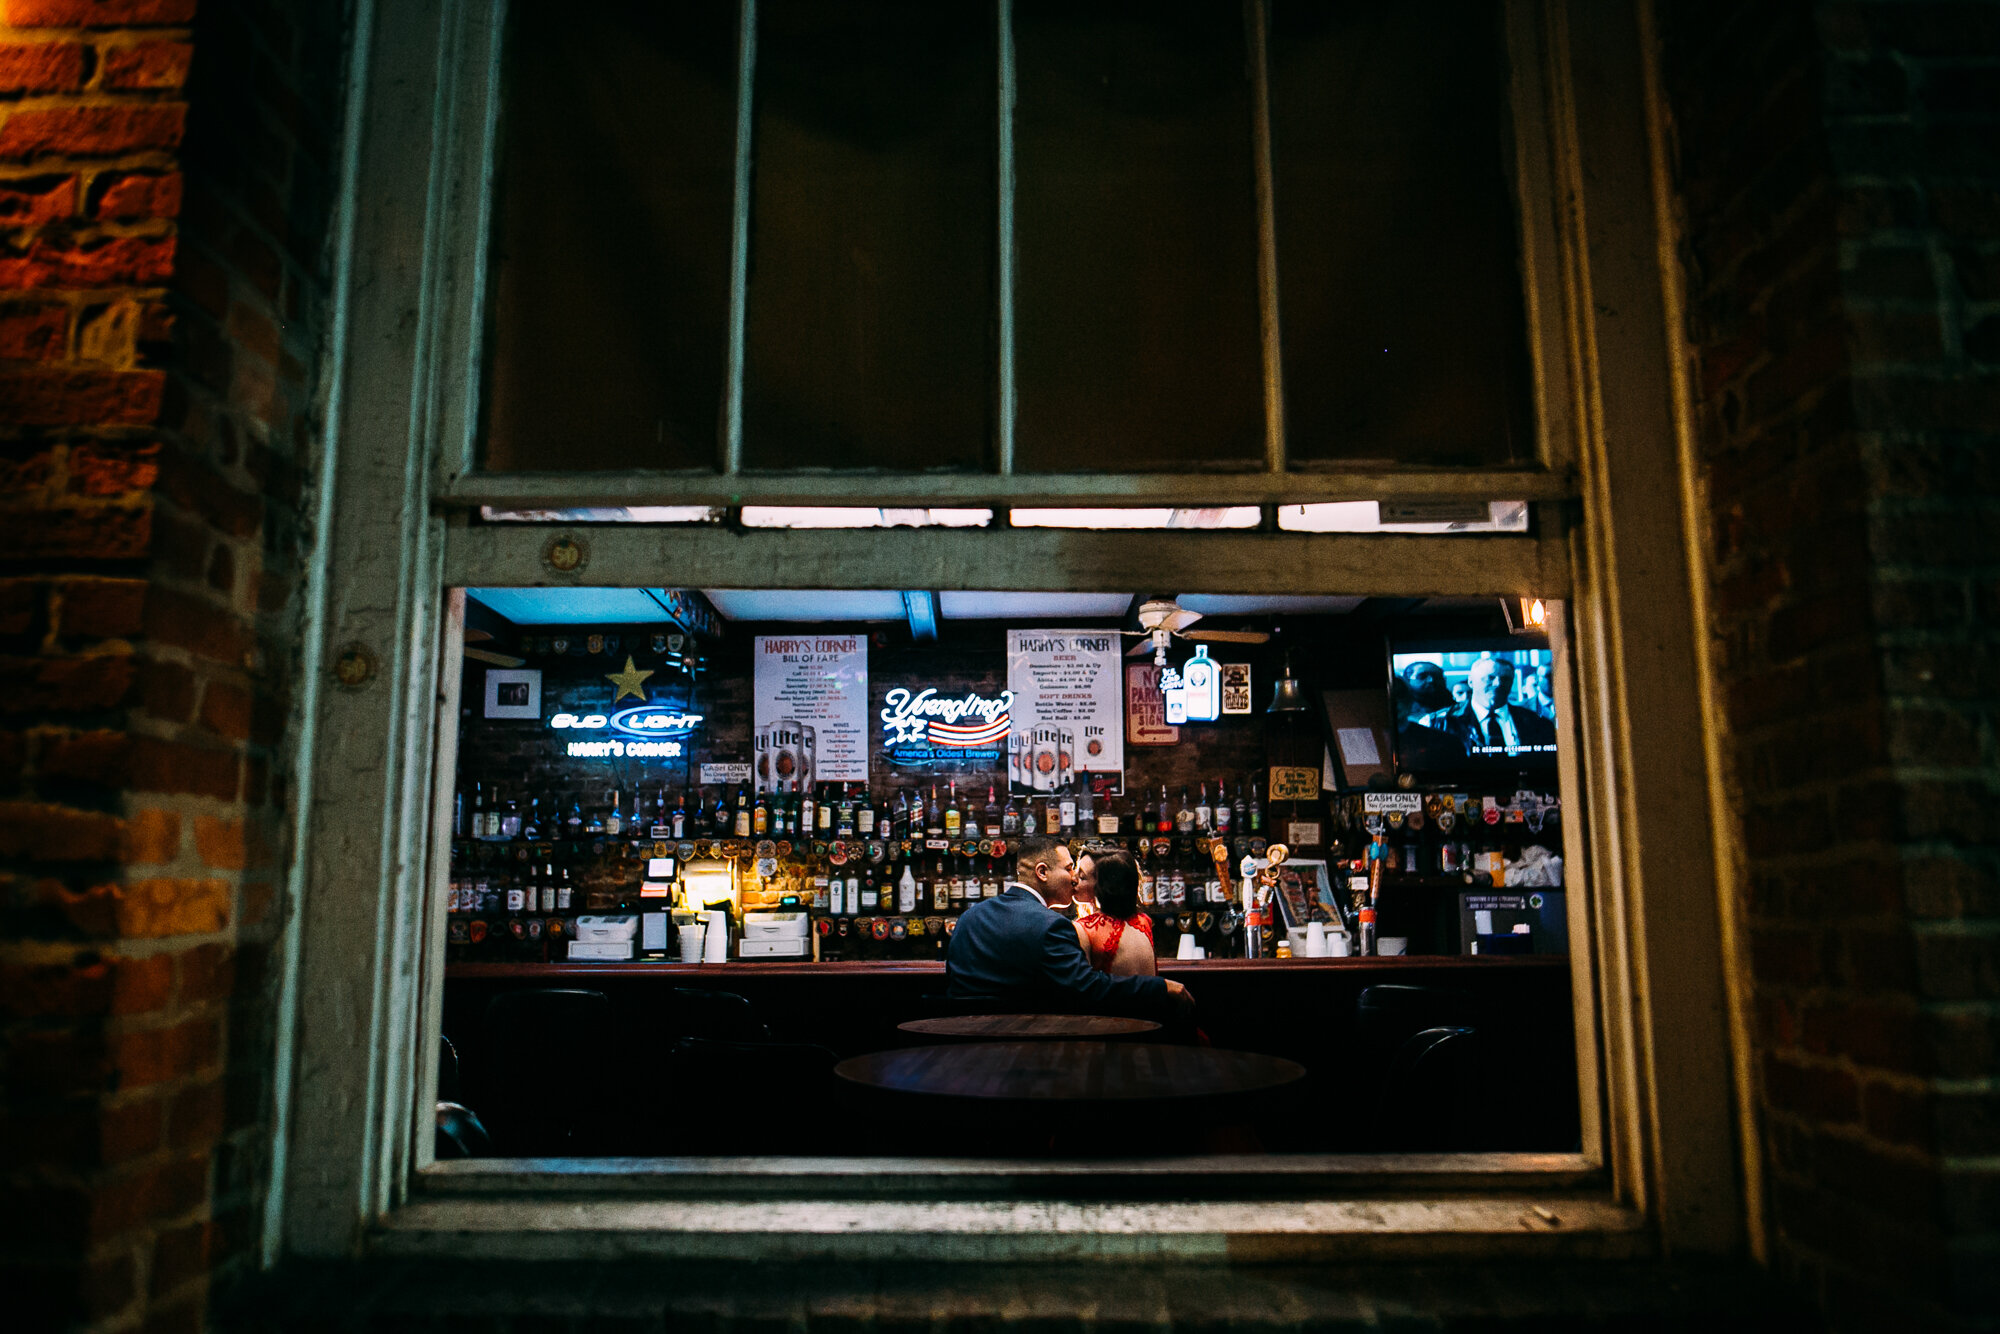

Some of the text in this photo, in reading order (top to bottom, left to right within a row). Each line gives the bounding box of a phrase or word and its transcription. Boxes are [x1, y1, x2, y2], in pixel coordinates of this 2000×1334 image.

[765, 639, 857, 654] HARRY'S CORNER
[1020, 638, 1110, 652] HARRY'S CORNER
[782, 655, 799, 663] BILL
[817, 654, 839, 662] FARE
[881, 688, 1014, 723] Yuengling
[1132, 703, 1163, 714] BETWE
[551, 713, 703, 728] BUD LIGHT
[1138, 715, 1163, 726] SIGN
[1034, 730, 1057, 745] Lite
[1085, 725, 1105, 737] Lite
[773, 730, 800, 749] Lite
[567, 740, 681, 757] HARRY'S CORNER
[894, 748, 1000, 761] America's Oldest Brewery
[1279, 784, 1299, 795] FUN
[1367, 794, 1419, 802] CASH ONLY
